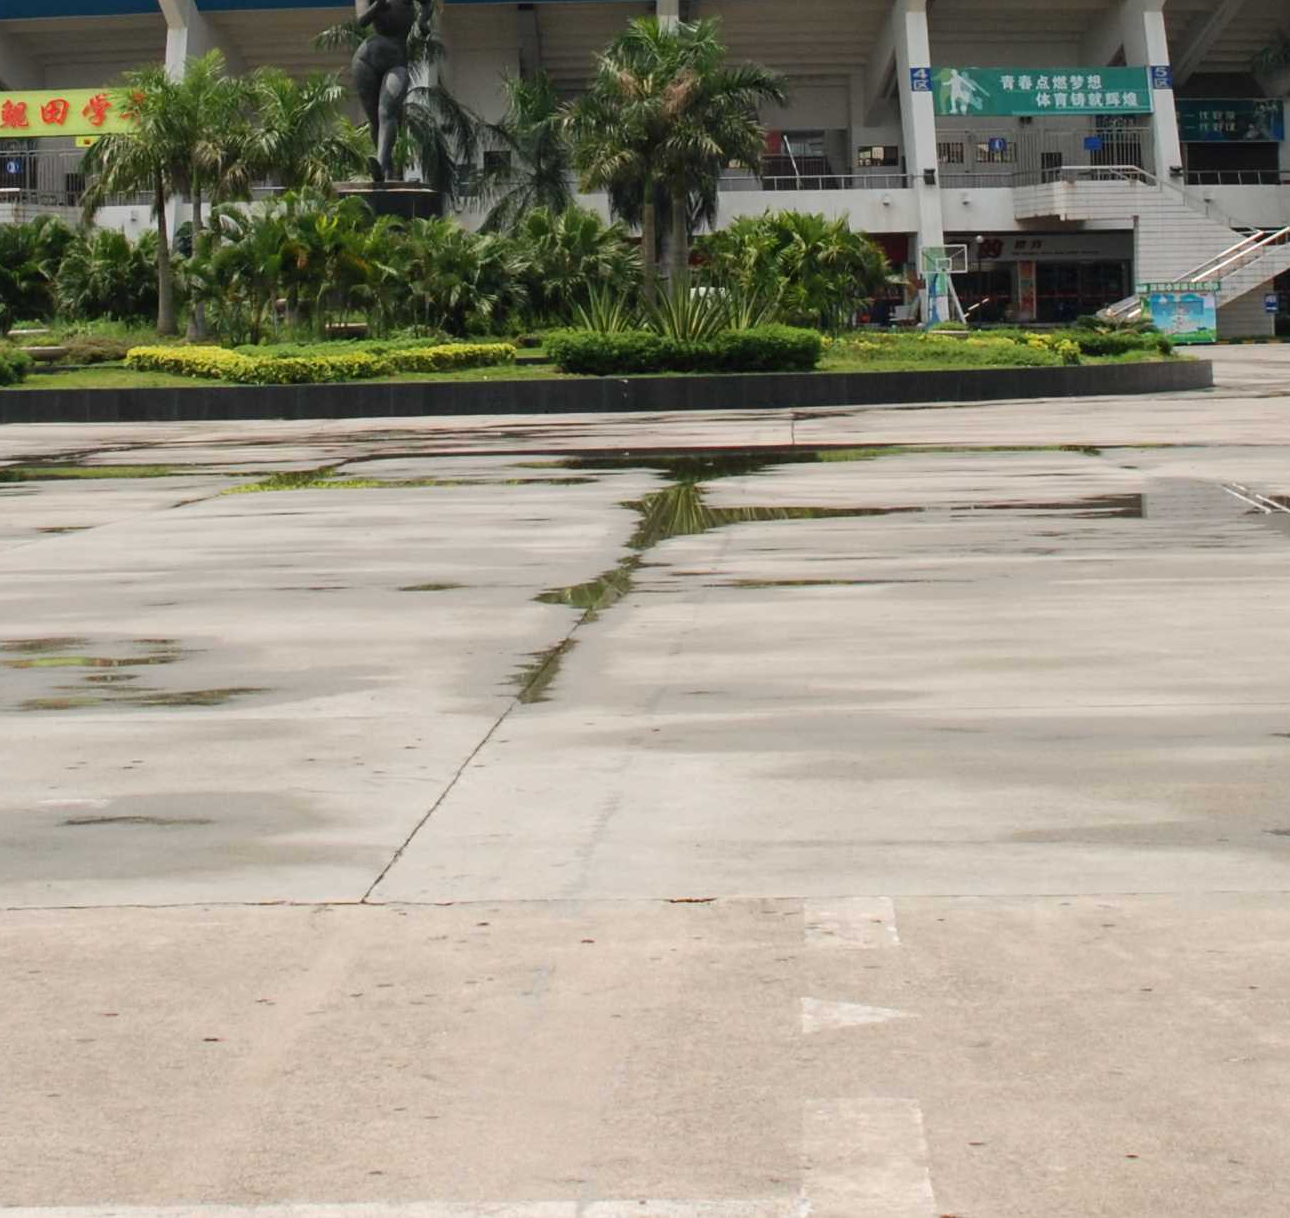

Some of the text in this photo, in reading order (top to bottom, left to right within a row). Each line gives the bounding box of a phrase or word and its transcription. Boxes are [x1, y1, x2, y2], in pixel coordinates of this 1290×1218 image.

[1000, 75, 1102, 90] 青春点燃梦想
